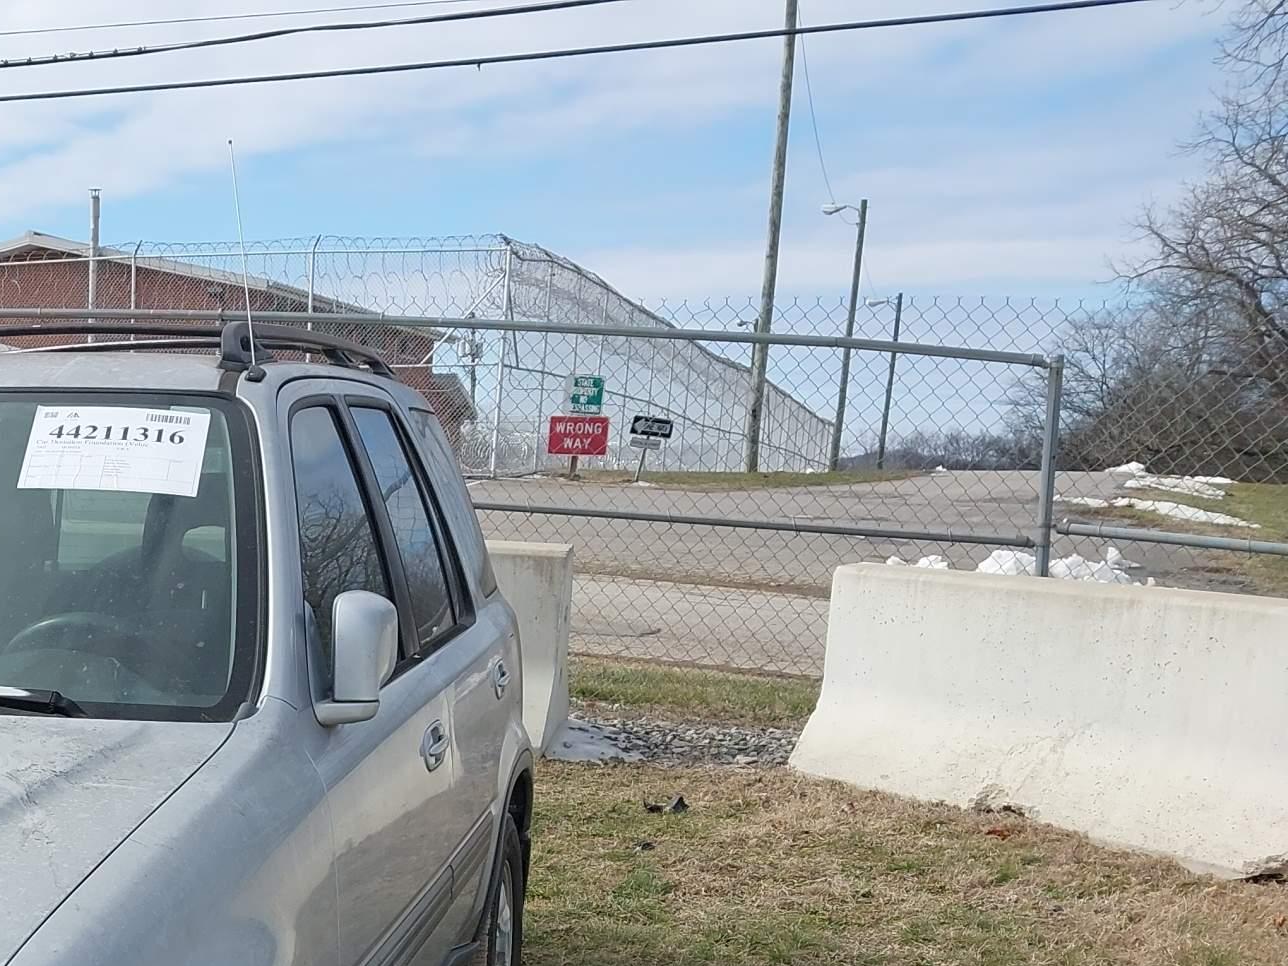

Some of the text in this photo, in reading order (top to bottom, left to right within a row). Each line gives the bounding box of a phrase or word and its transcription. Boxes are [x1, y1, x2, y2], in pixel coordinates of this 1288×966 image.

[556, 422, 603, 434] WRONG
[49, 424, 185, 445] 44211316
[563, 438, 592, 449] WAY
